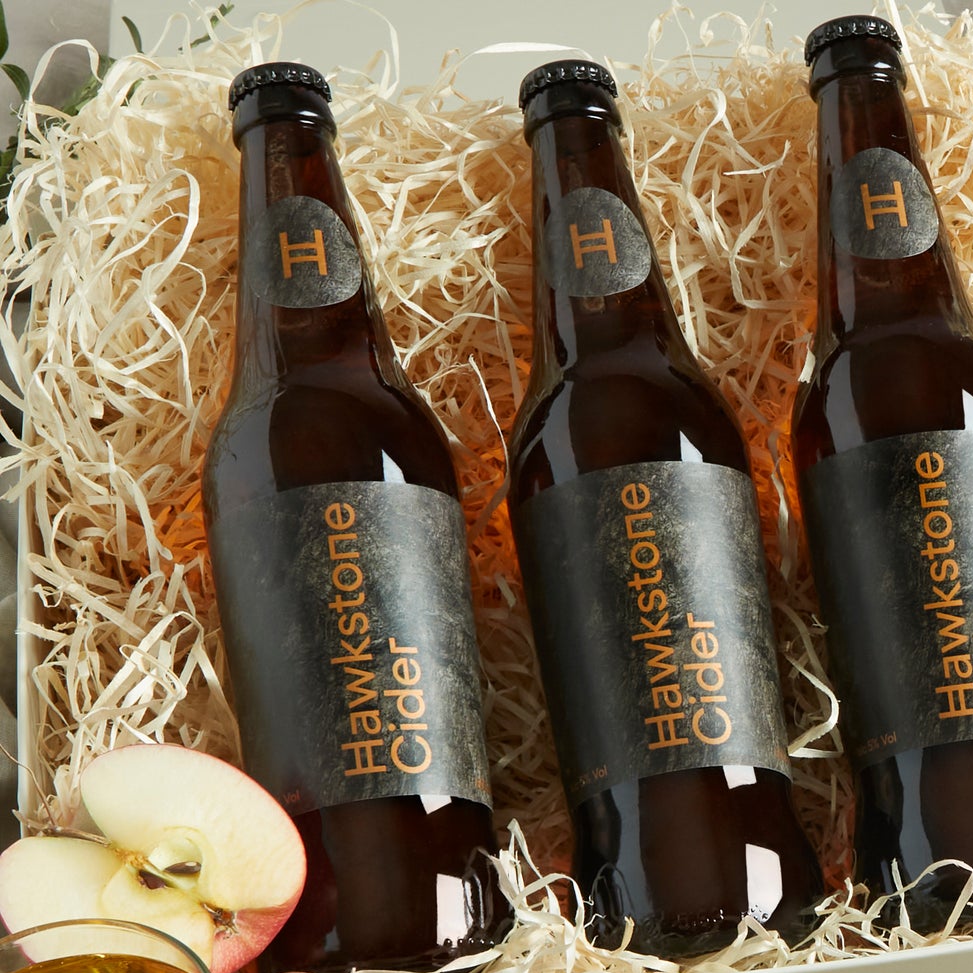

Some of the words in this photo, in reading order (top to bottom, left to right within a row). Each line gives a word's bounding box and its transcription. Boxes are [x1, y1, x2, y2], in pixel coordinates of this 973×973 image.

[324, 502, 387, 777] Hawkstone
[387, 637, 433, 775] Cider
[622, 482, 689, 750] Hawkstone
[683, 612, 732, 745] Cider
